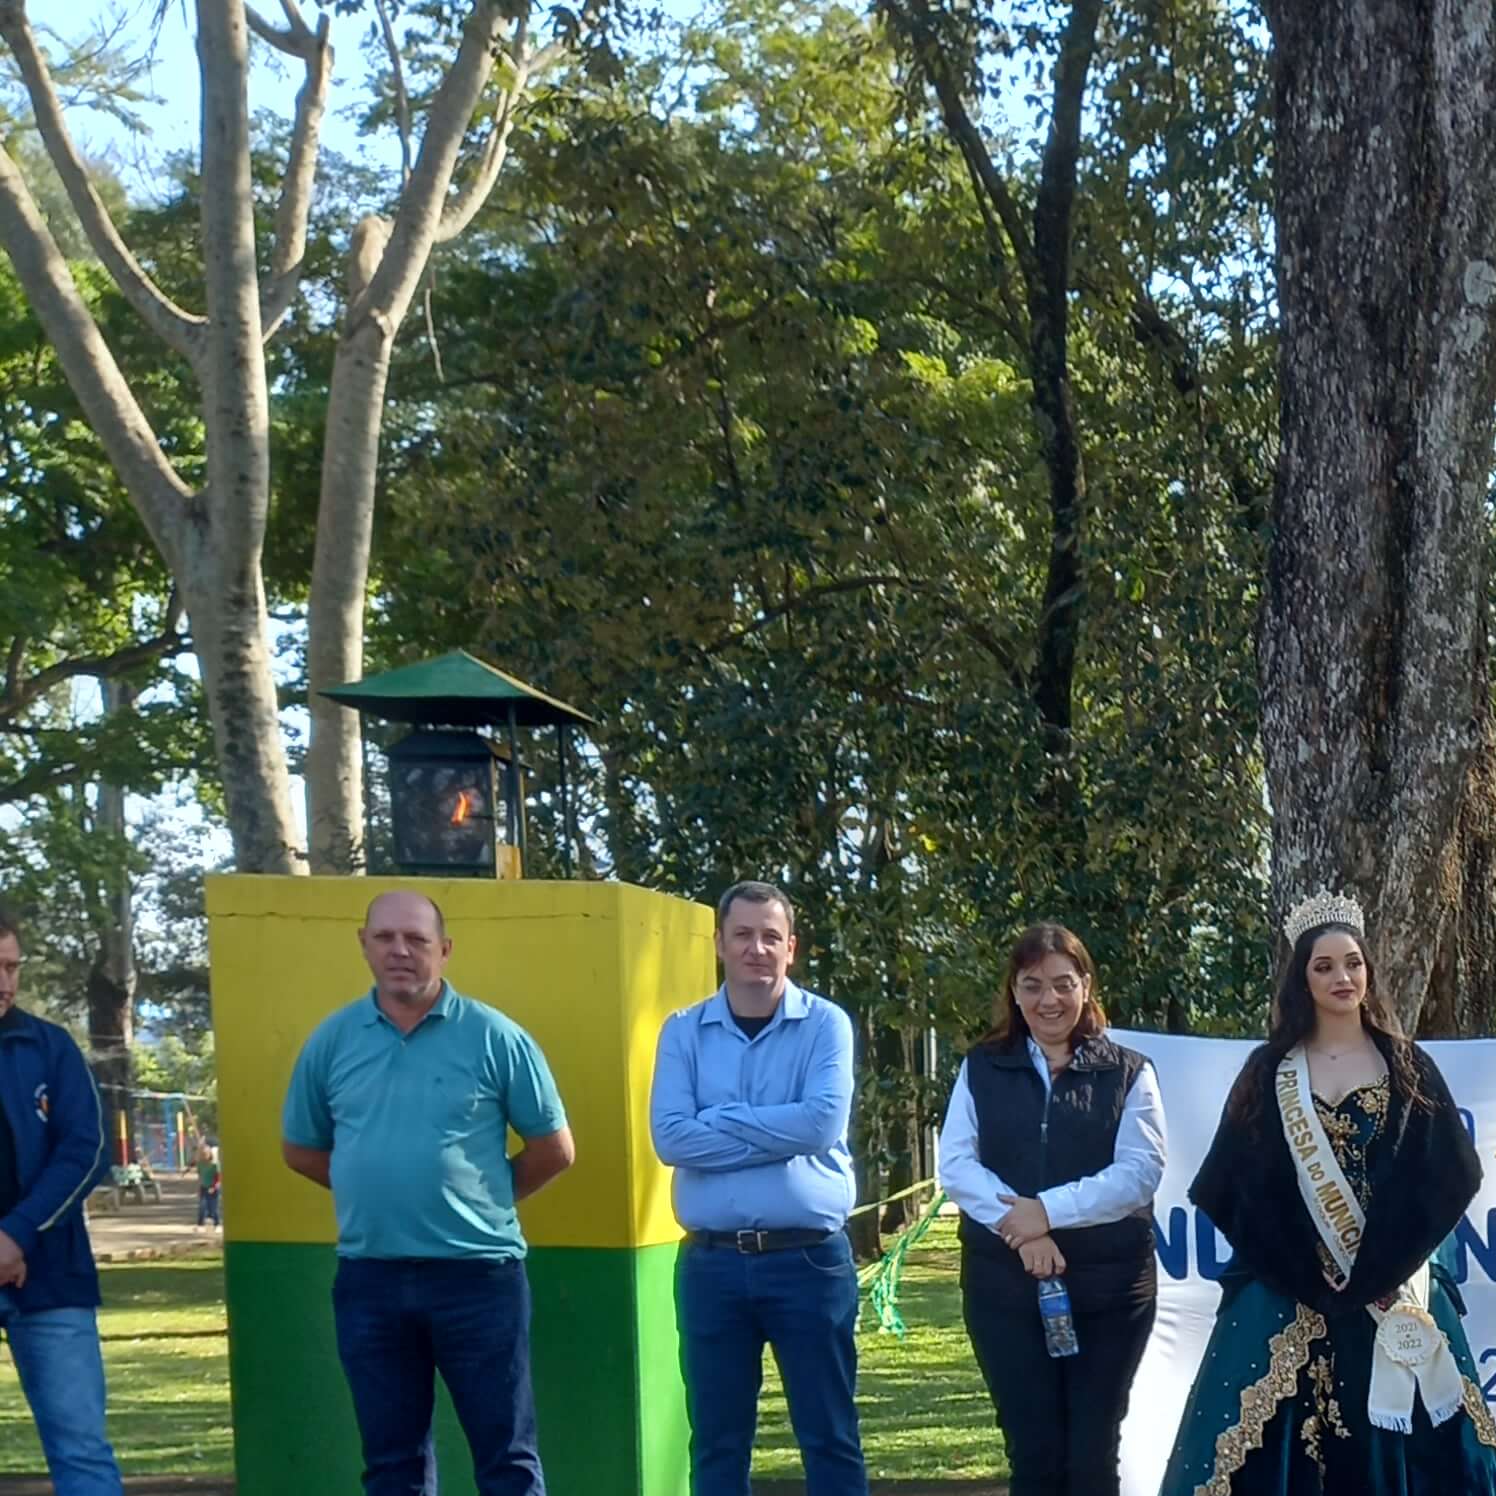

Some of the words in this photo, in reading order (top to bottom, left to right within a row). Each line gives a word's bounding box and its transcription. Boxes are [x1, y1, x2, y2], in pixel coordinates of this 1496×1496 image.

[1277, 1070, 1319, 1162] PRINCESA
[1307, 1161, 1325, 1181] DO
[1395, 1322, 1417, 1334] 2021
